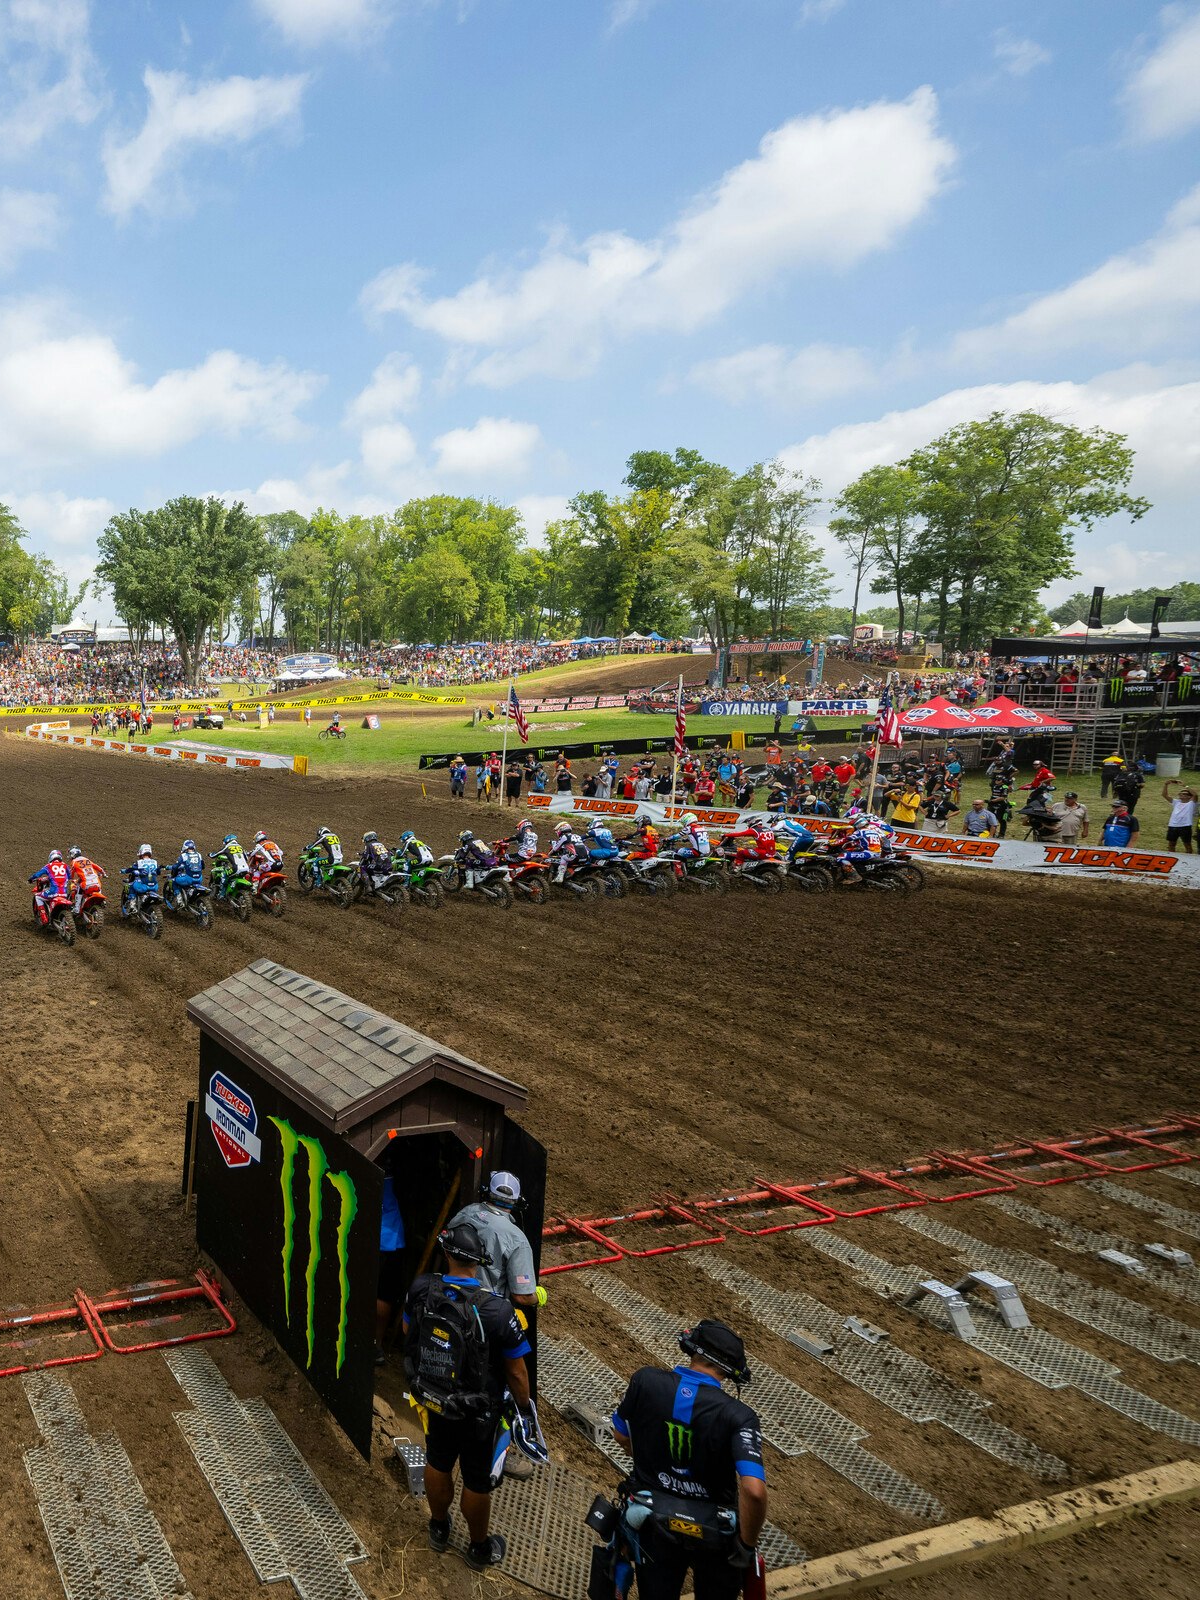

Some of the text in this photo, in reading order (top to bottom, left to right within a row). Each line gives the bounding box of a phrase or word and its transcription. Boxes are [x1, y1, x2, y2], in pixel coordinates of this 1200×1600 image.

[768, 641, 804, 652] HOLESHOT
[725, 703, 777, 715] YAMAHA
[801, 701, 868, 710] PARTS
[235, 757, 261, 767] TUCKER
[573, 799, 638, 815] TUCKER
[664, 807, 740, 825] TUKER
[326, 836, 340, 845] 30
[895, 832, 1000, 857] TUCKER
[1043, 846, 1179, 873] TUCKER
[51, 864, 66, 875] 96
[215, 1080, 250, 1117] TUCKER
[215, 1107, 246, 1145] IRONMAN
[214, 1127, 246, 1158] NATIONAL
